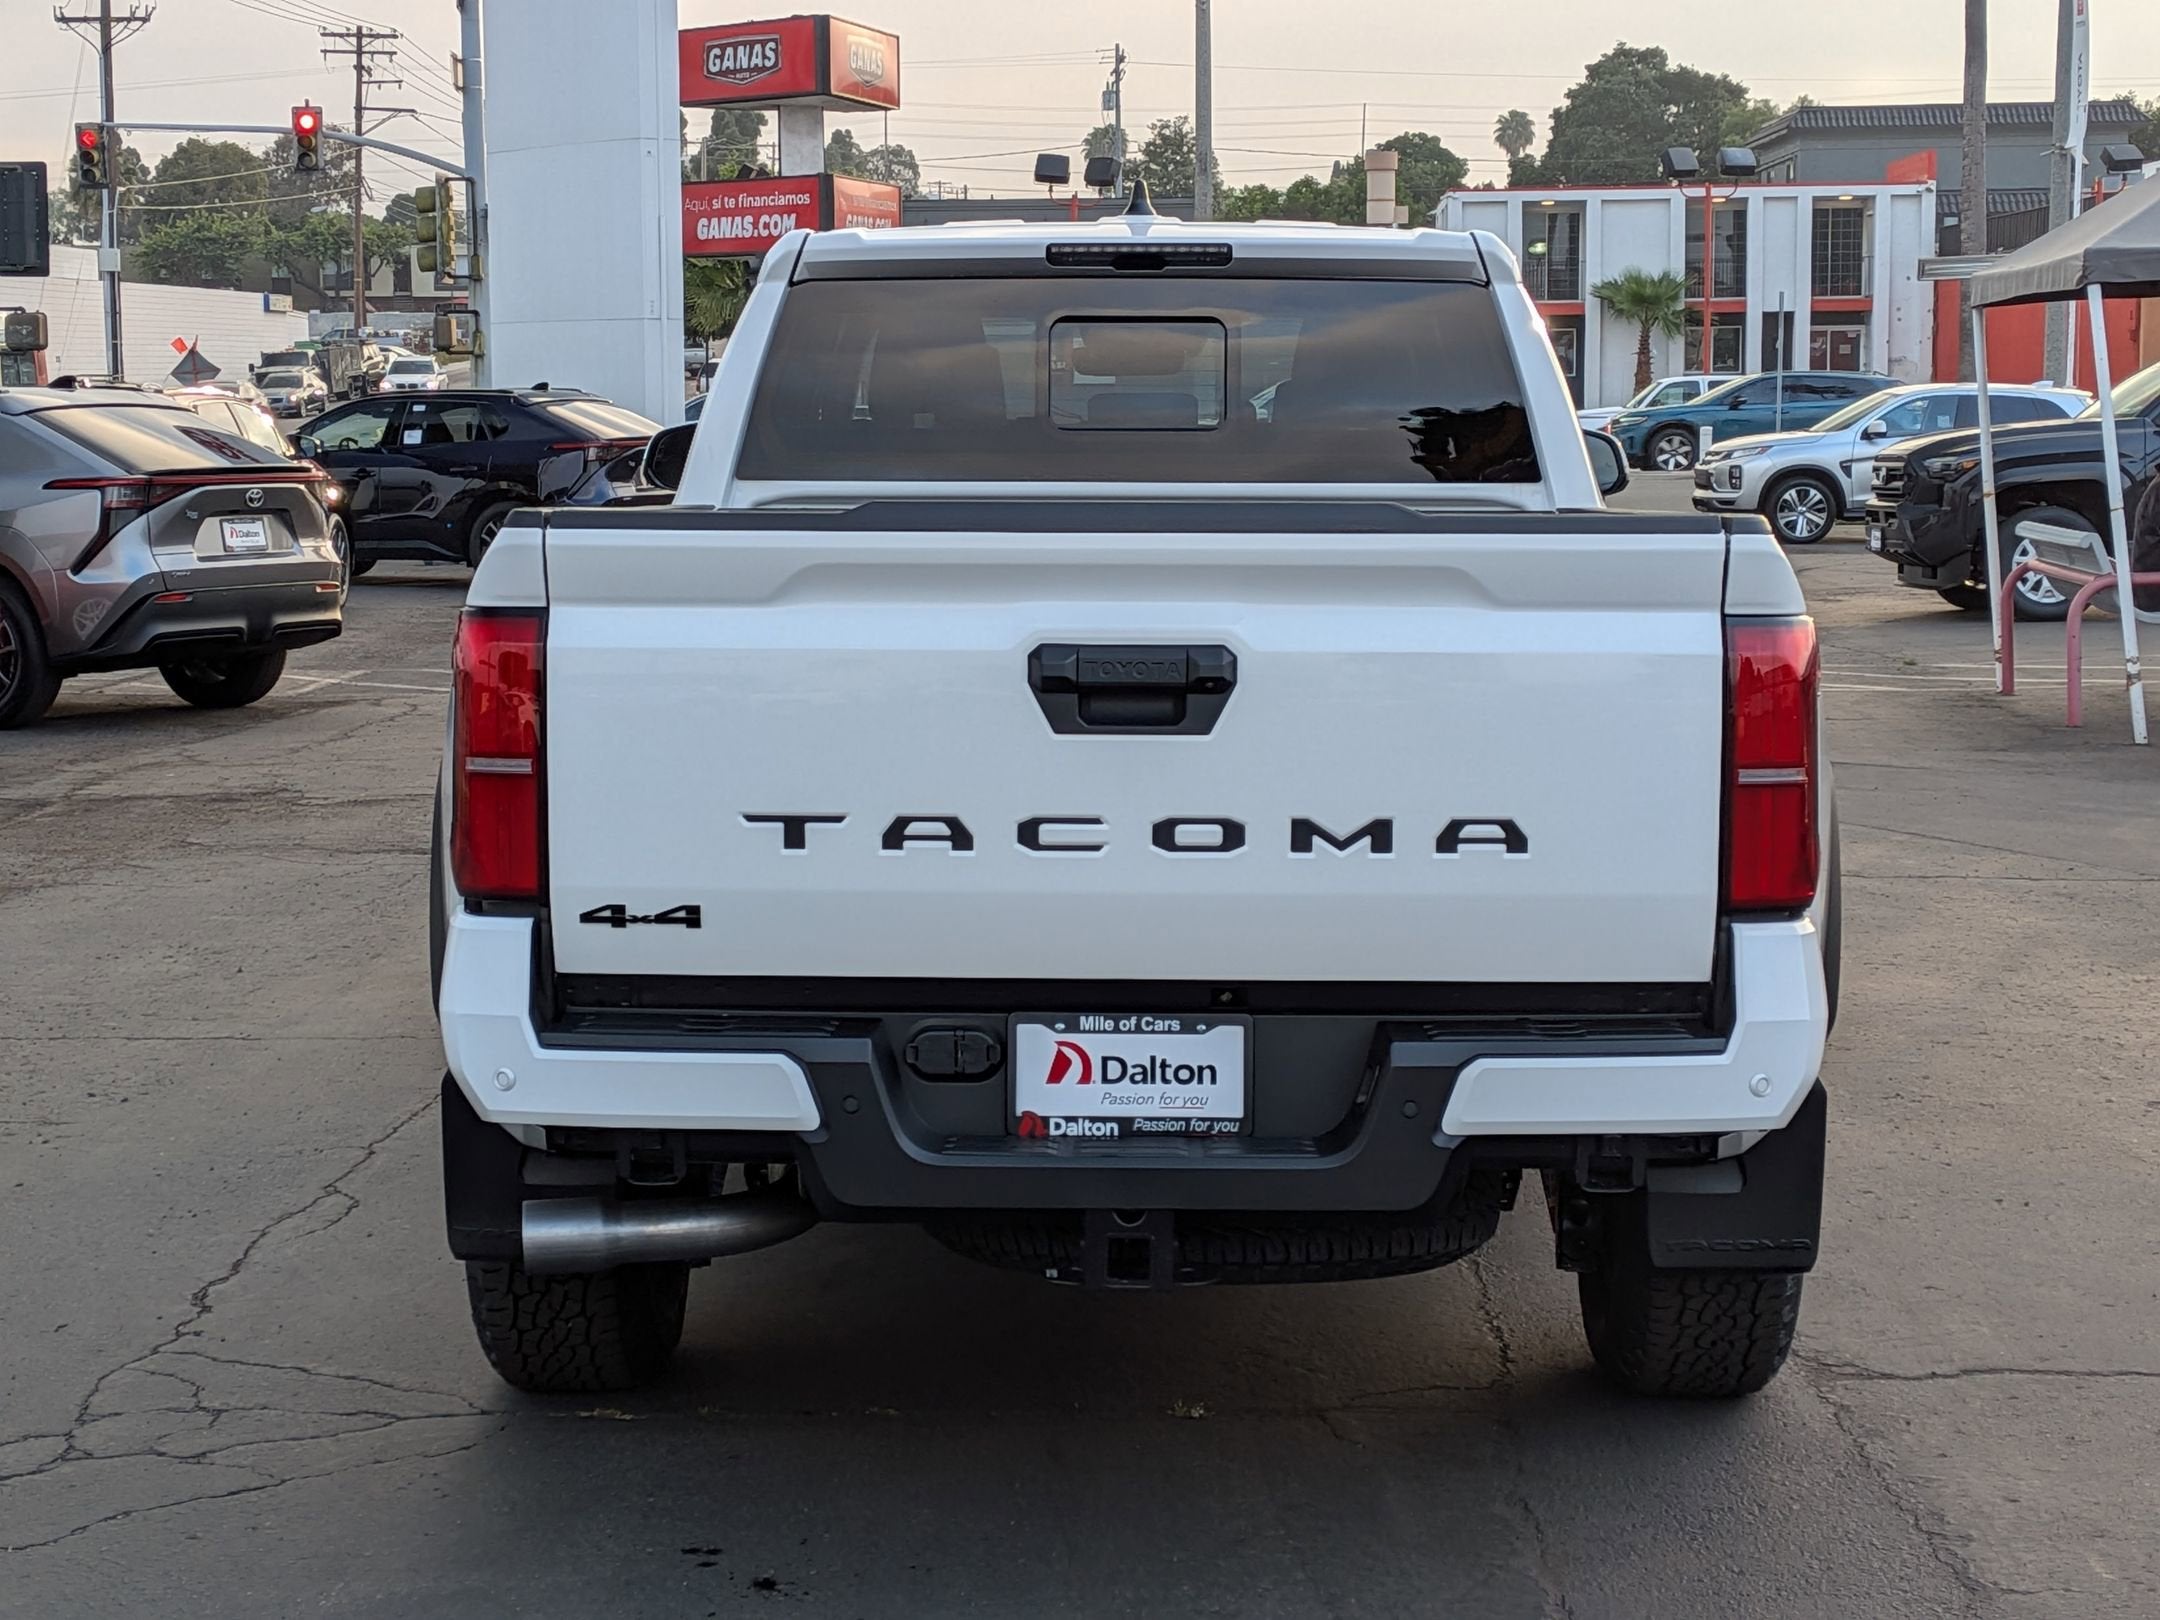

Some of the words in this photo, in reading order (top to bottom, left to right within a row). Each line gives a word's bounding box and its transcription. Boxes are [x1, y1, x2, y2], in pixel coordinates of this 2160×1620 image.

[708, 41, 776, 73] GANAS
[850, 44, 883, 76] GANAS
[712, 194, 721, 209] sí
[724, 196, 735, 208] te
[738, 191, 810, 208] financiamos
[697, 213, 797, 240] GANAS.COM
[238, 529, 261, 538] Dalton
[1083, 661, 1182, 678] TOYOTA
[742, 814, 1529, 853] TACOMA
[1079, 1016, 1114, 1031] Mile
[1119, 1016, 1136, 1031] of
[1141, 1016, 1181, 1032] Cars
[1100, 1055, 1217, 1085] Dalton
[1101, 1092, 1154, 1105] Passion
[1158, 1092, 1180, 1106] for
[1181, 1095, 1209, 1107] you
[1050, 1118, 1119, 1136] Dalton
[1132, 1118, 1185, 1131] Passion
[1189, 1118, 1209, 1132] for
[1211, 1120, 1240, 1133] you
